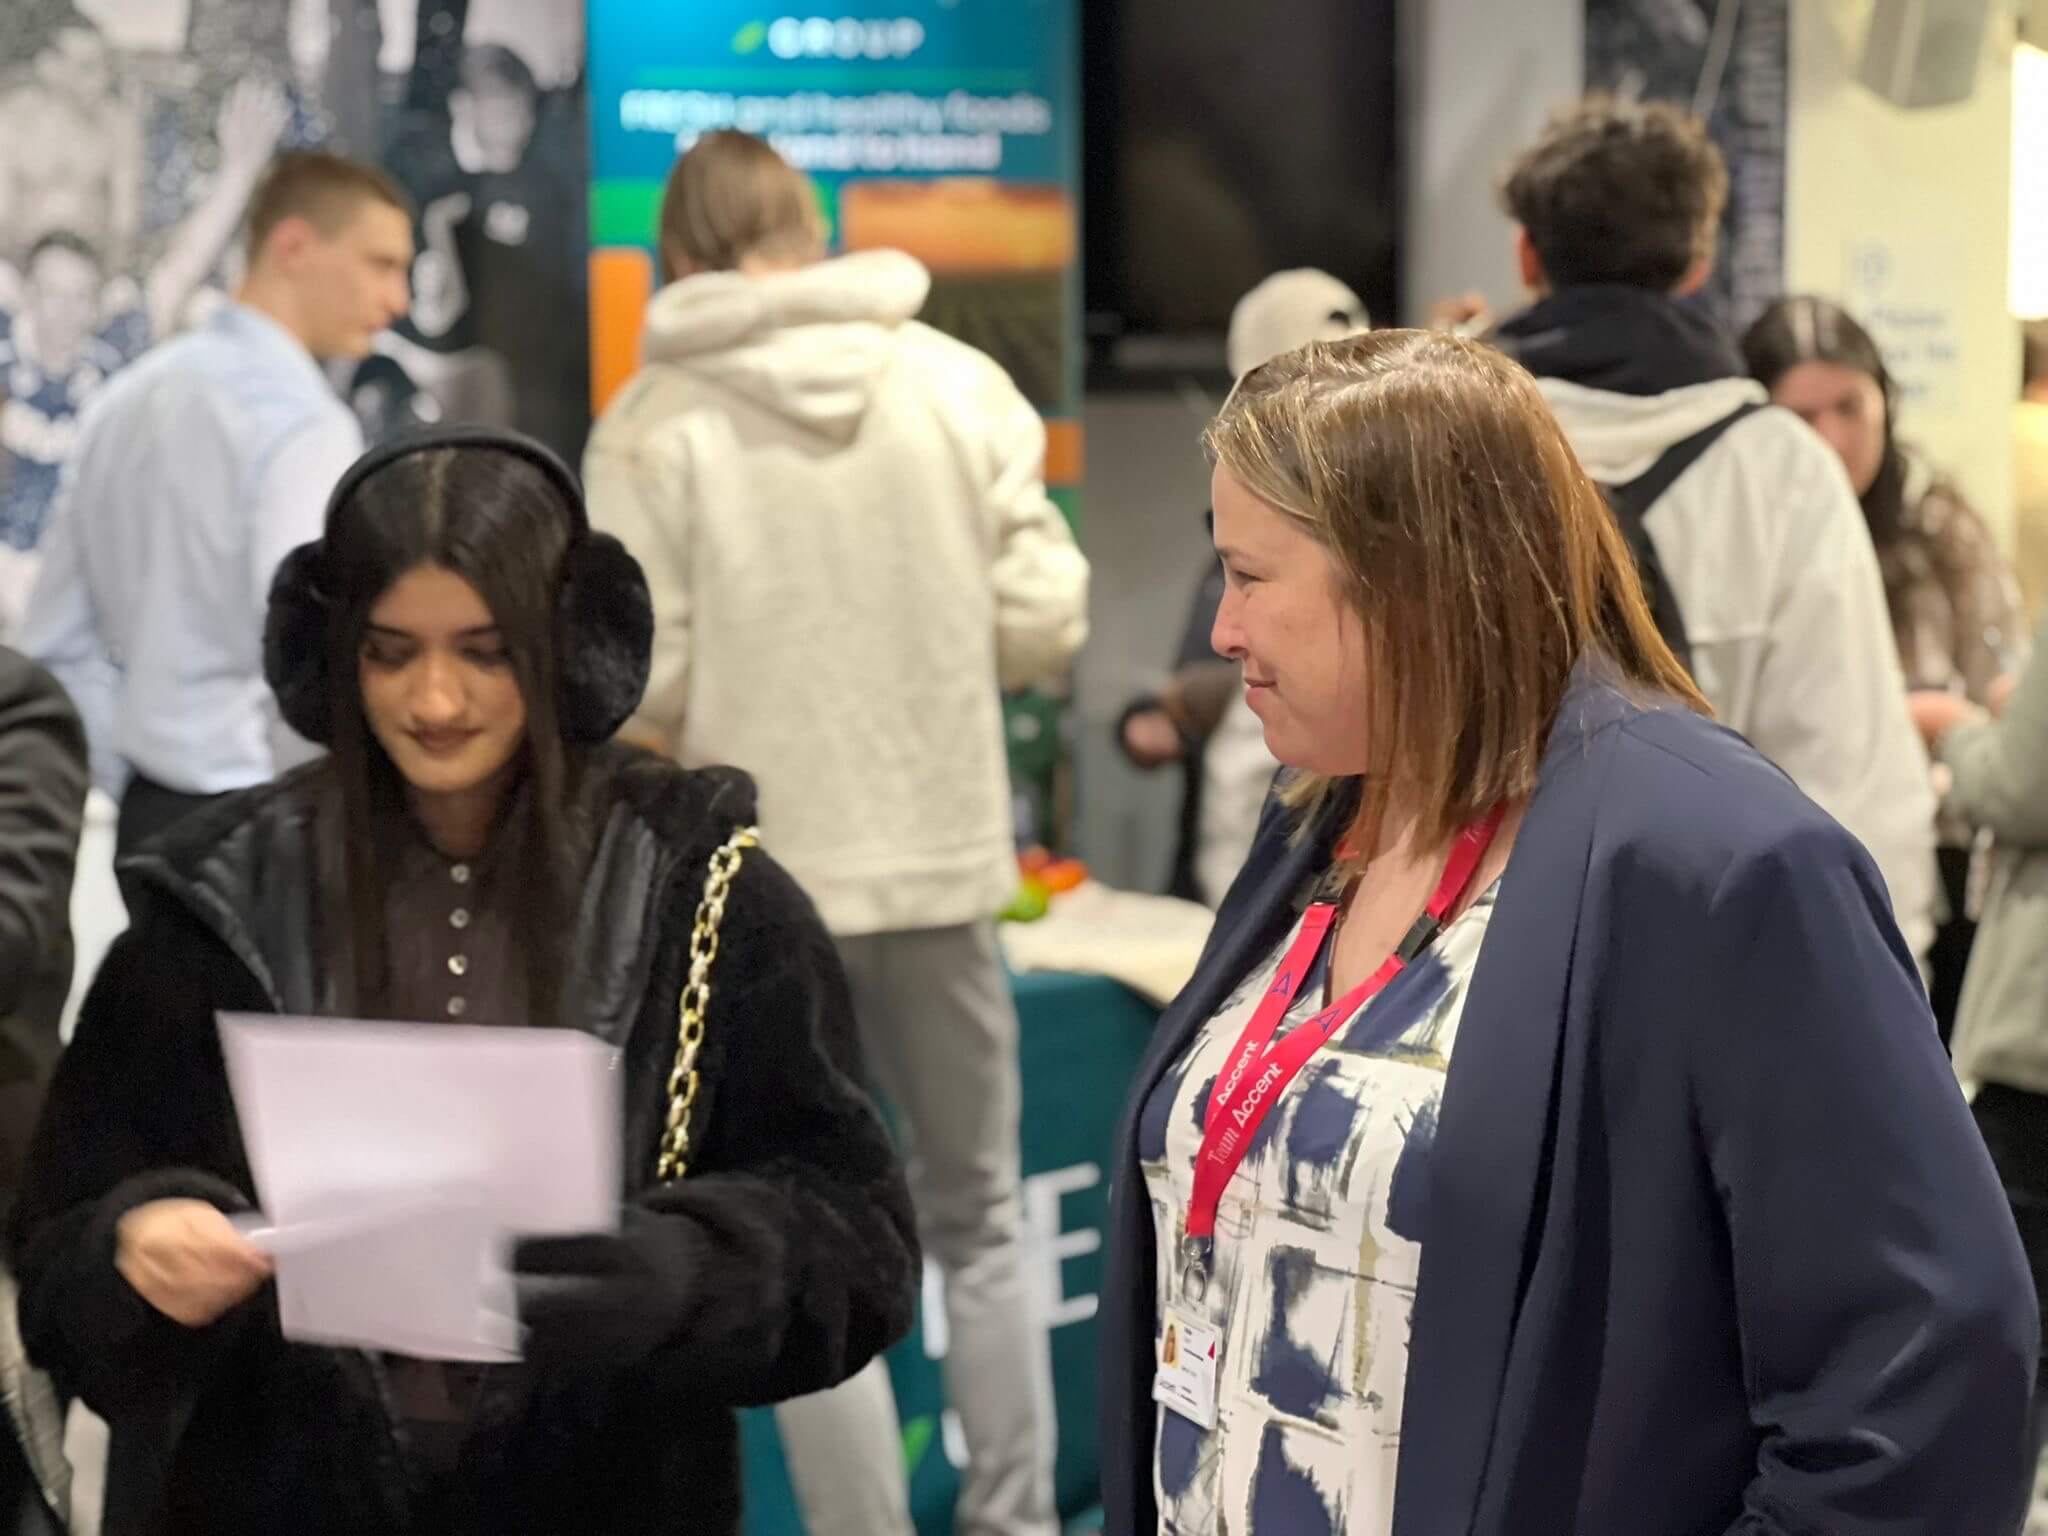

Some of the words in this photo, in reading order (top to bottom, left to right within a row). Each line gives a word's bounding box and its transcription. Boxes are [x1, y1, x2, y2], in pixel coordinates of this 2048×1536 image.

[769, 17, 924, 59] GROUP
[1216, 1040, 1259, 1106] Accent
[1207, 1127, 1239, 1165] Team
[1231, 1062, 1283, 1128] Accent
